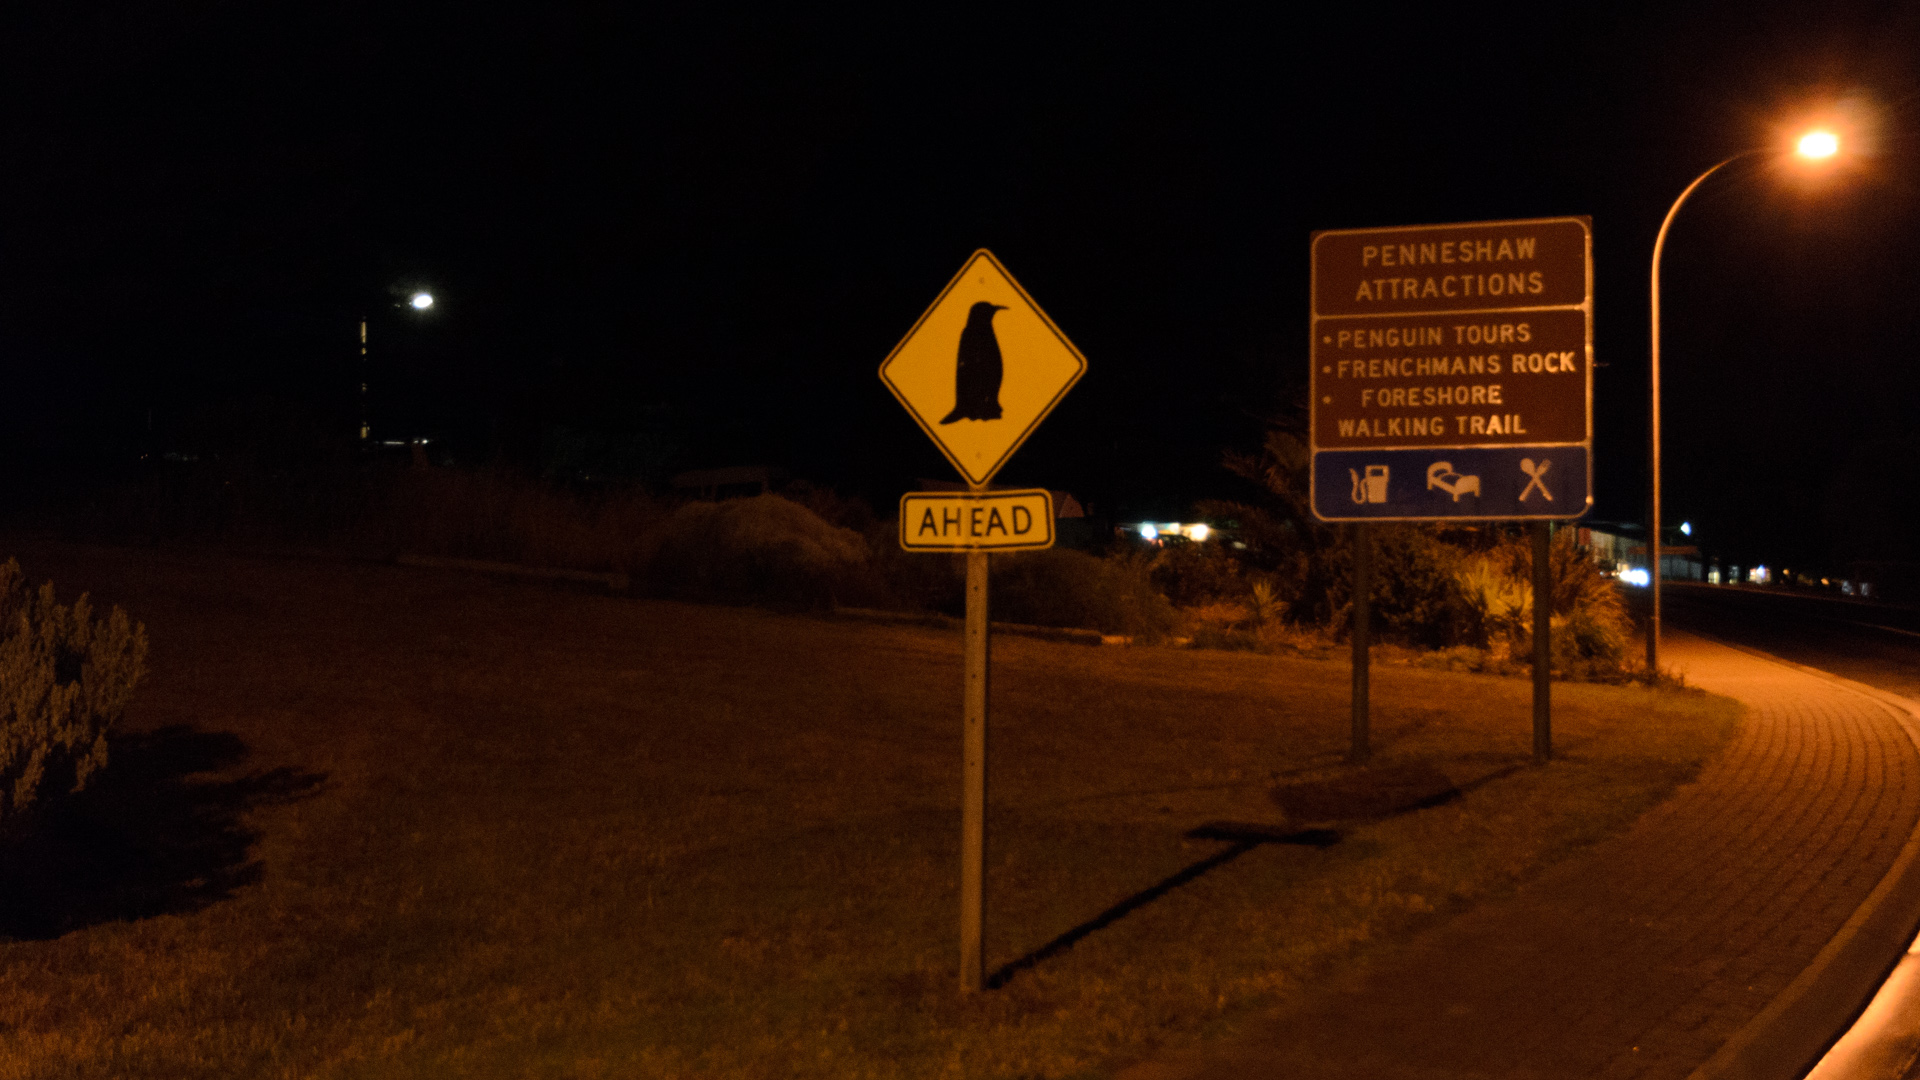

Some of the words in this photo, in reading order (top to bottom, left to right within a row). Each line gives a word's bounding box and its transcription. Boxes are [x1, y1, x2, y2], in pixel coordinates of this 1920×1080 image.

[1362, 237, 1537, 267] PENNESHAW
[1355, 271, 1545, 301] ATTRACTIONS
[1337, 326, 1442, 348] PENGUIN
[1454, 323, 1532, 345] TOURS
[1337, 354, 1502, 379] FRENCHMANS
[1512, 351, 1577, 373] ROCK
[1361, 384, 1503, 408] FORESHORE
[1338, 416, 1444, 437] WALKING
[1456, 414, 1527, 436] TRAIL
[918, 505, 1033, 537] AHEAD
